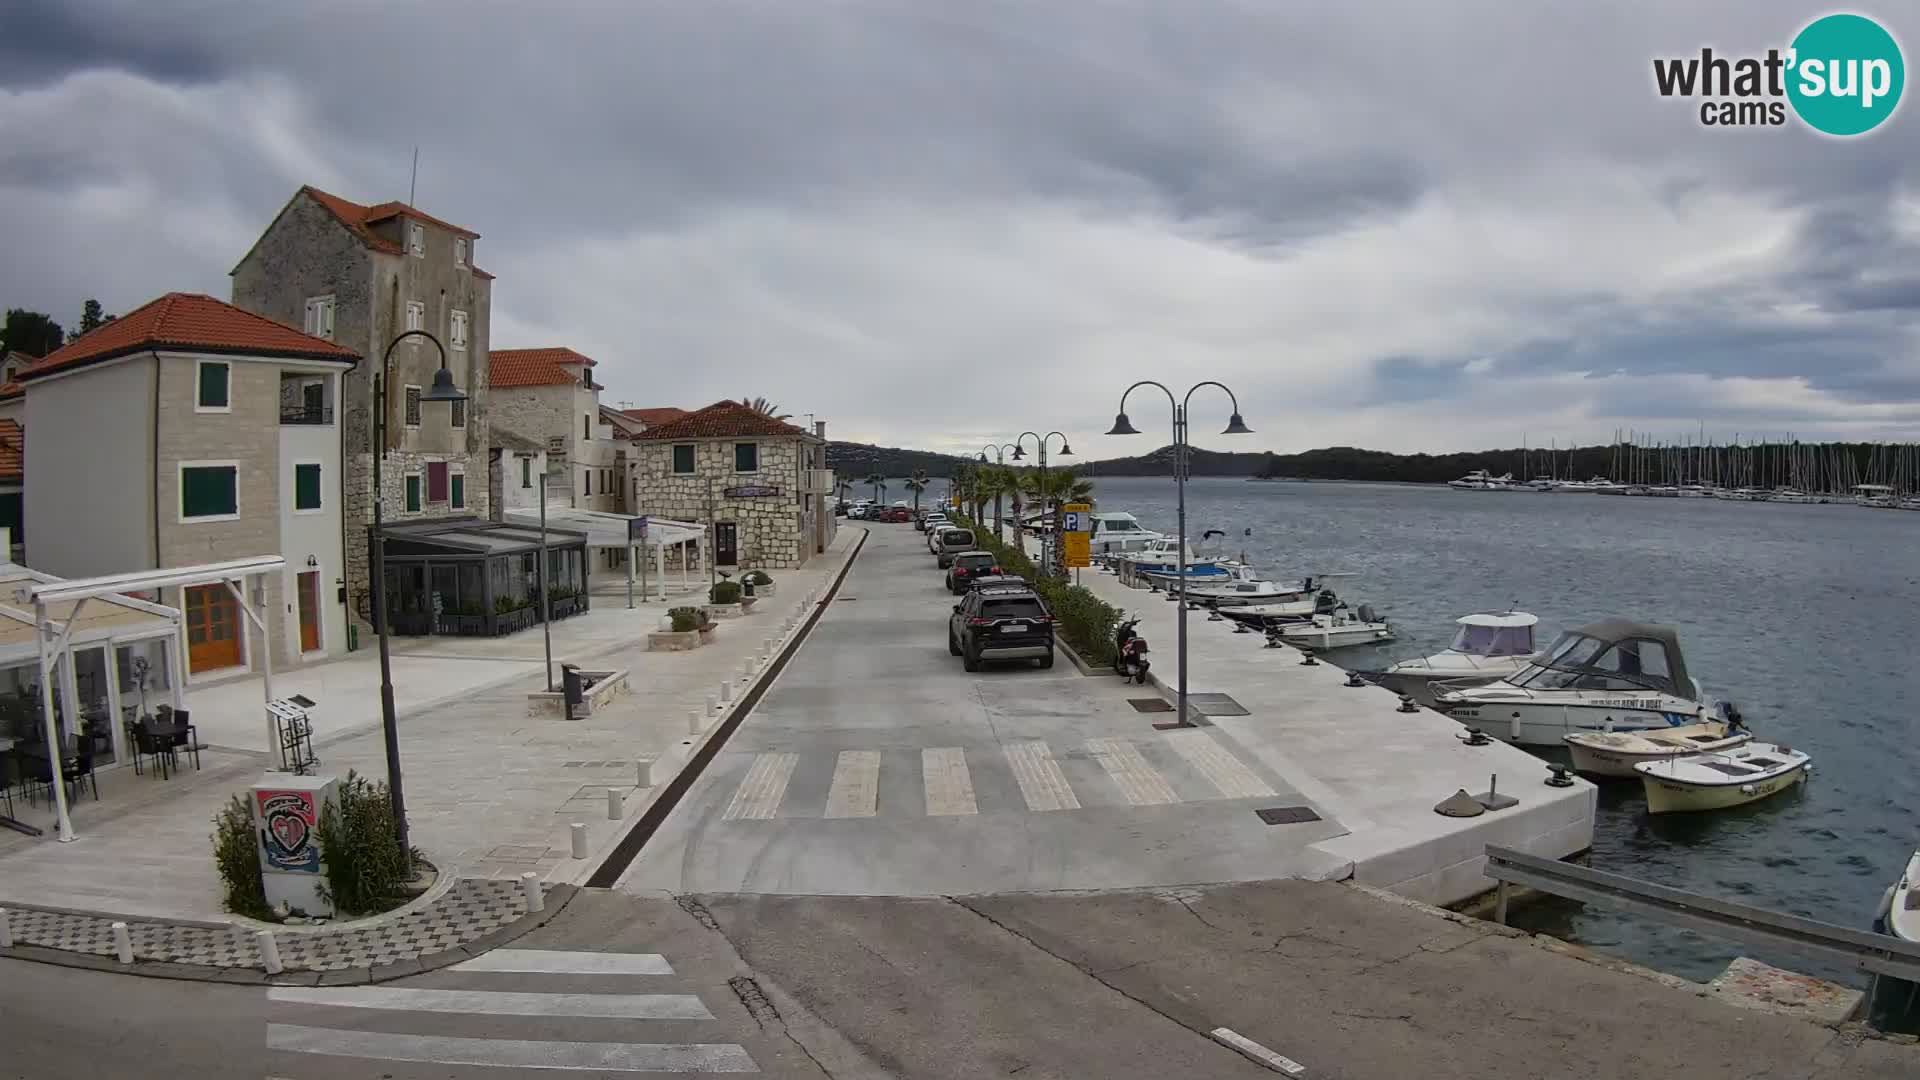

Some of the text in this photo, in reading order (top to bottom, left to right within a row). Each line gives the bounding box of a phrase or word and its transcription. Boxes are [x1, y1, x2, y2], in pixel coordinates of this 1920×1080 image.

[1066, 514, 1077, 529] P
[1621, 699, 1639, 708] RENT
[1646, 699, 1662, 709] BOAT
